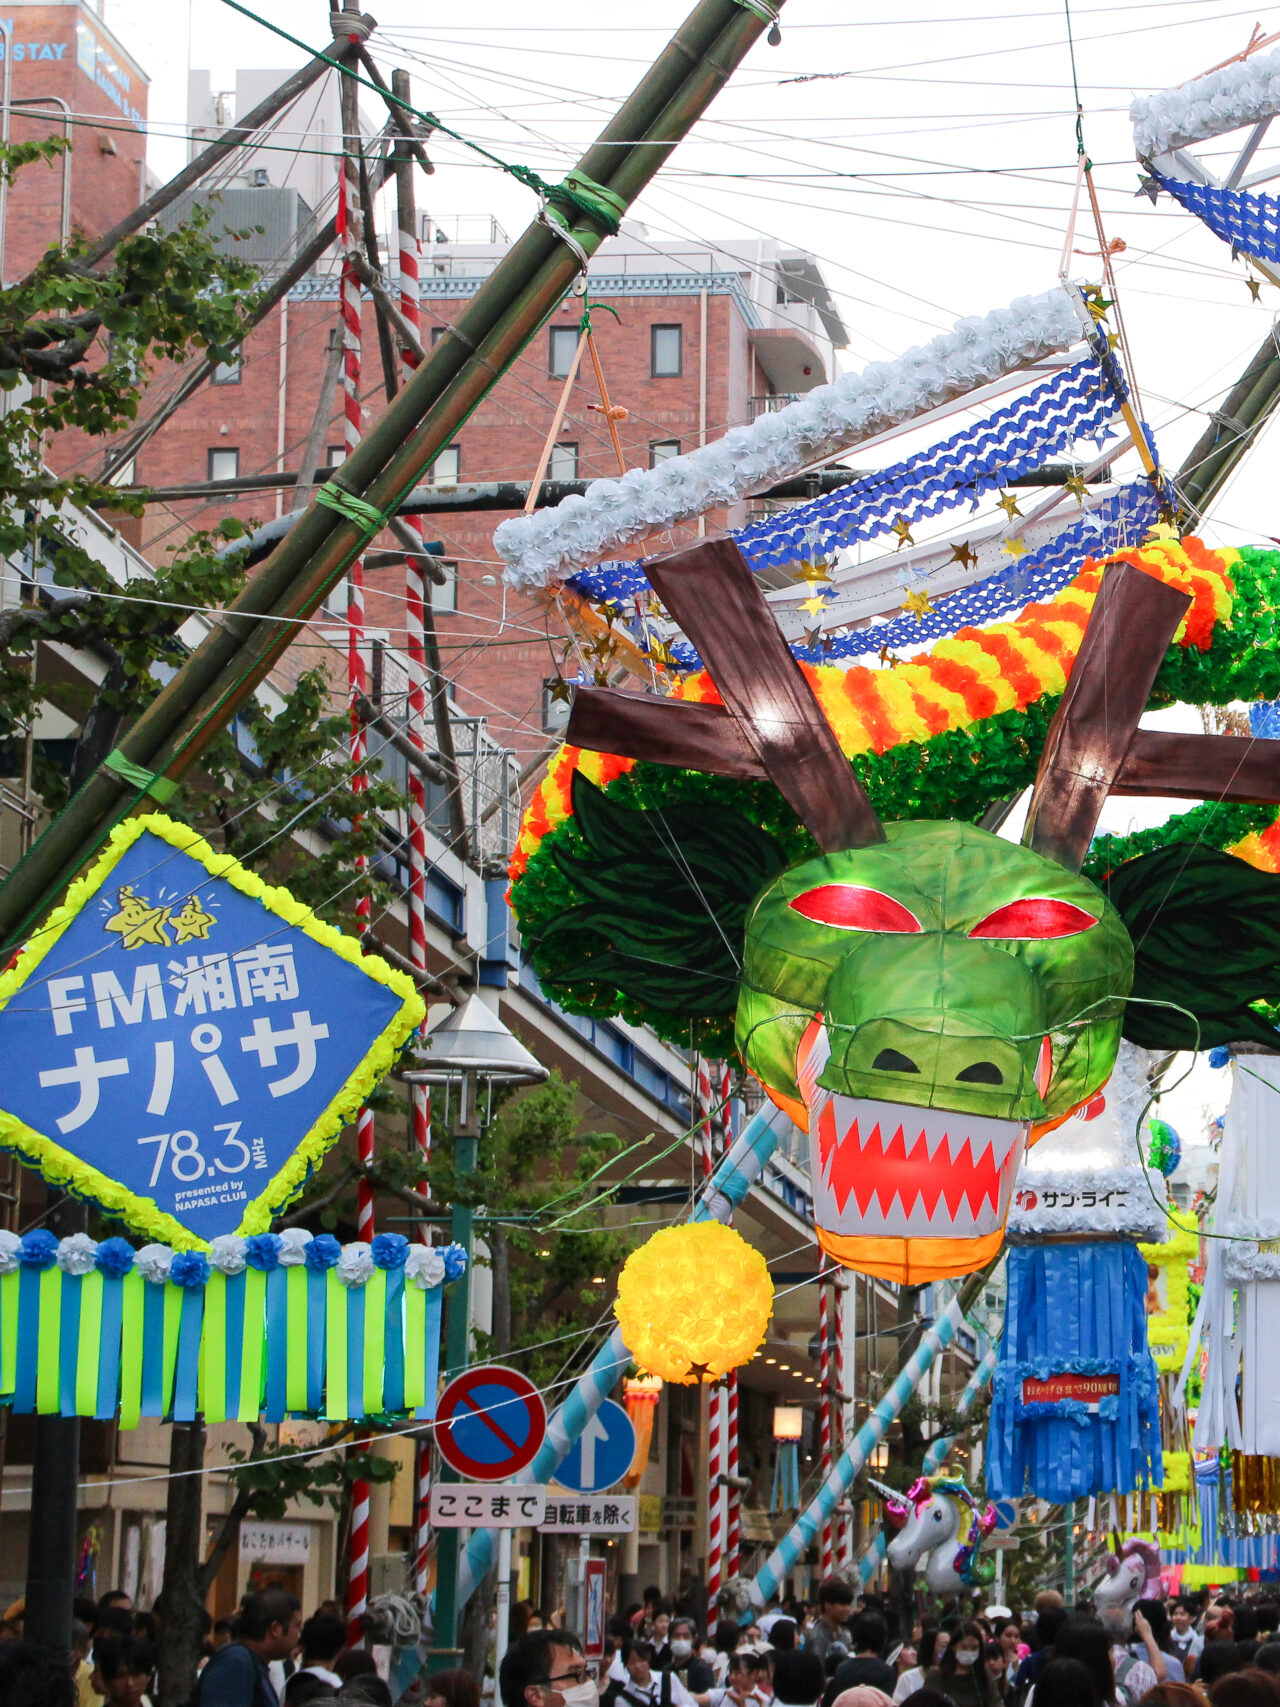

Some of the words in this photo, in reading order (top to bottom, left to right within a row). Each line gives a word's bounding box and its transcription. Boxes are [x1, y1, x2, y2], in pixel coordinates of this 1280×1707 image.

[13, 43, 67, 61] STAY
[47, 943, 300, 1036] FM湘南
[38, 1011, 329, 1134] ナパサ
[137, 1120, 250, 1187] 78.3
[252, 1137, 268, 1170] MHz
[175, 1182, 229, 1202] presented
[230, 1181, 244, 1192] by
[175, 1196, 219, 1212] NAPASA
[220, 1191, 247, 1203] CLUB
[438, 1496, 538, 1518] ここまで
[544, 1504, 630, 1526] 自転車を除く
